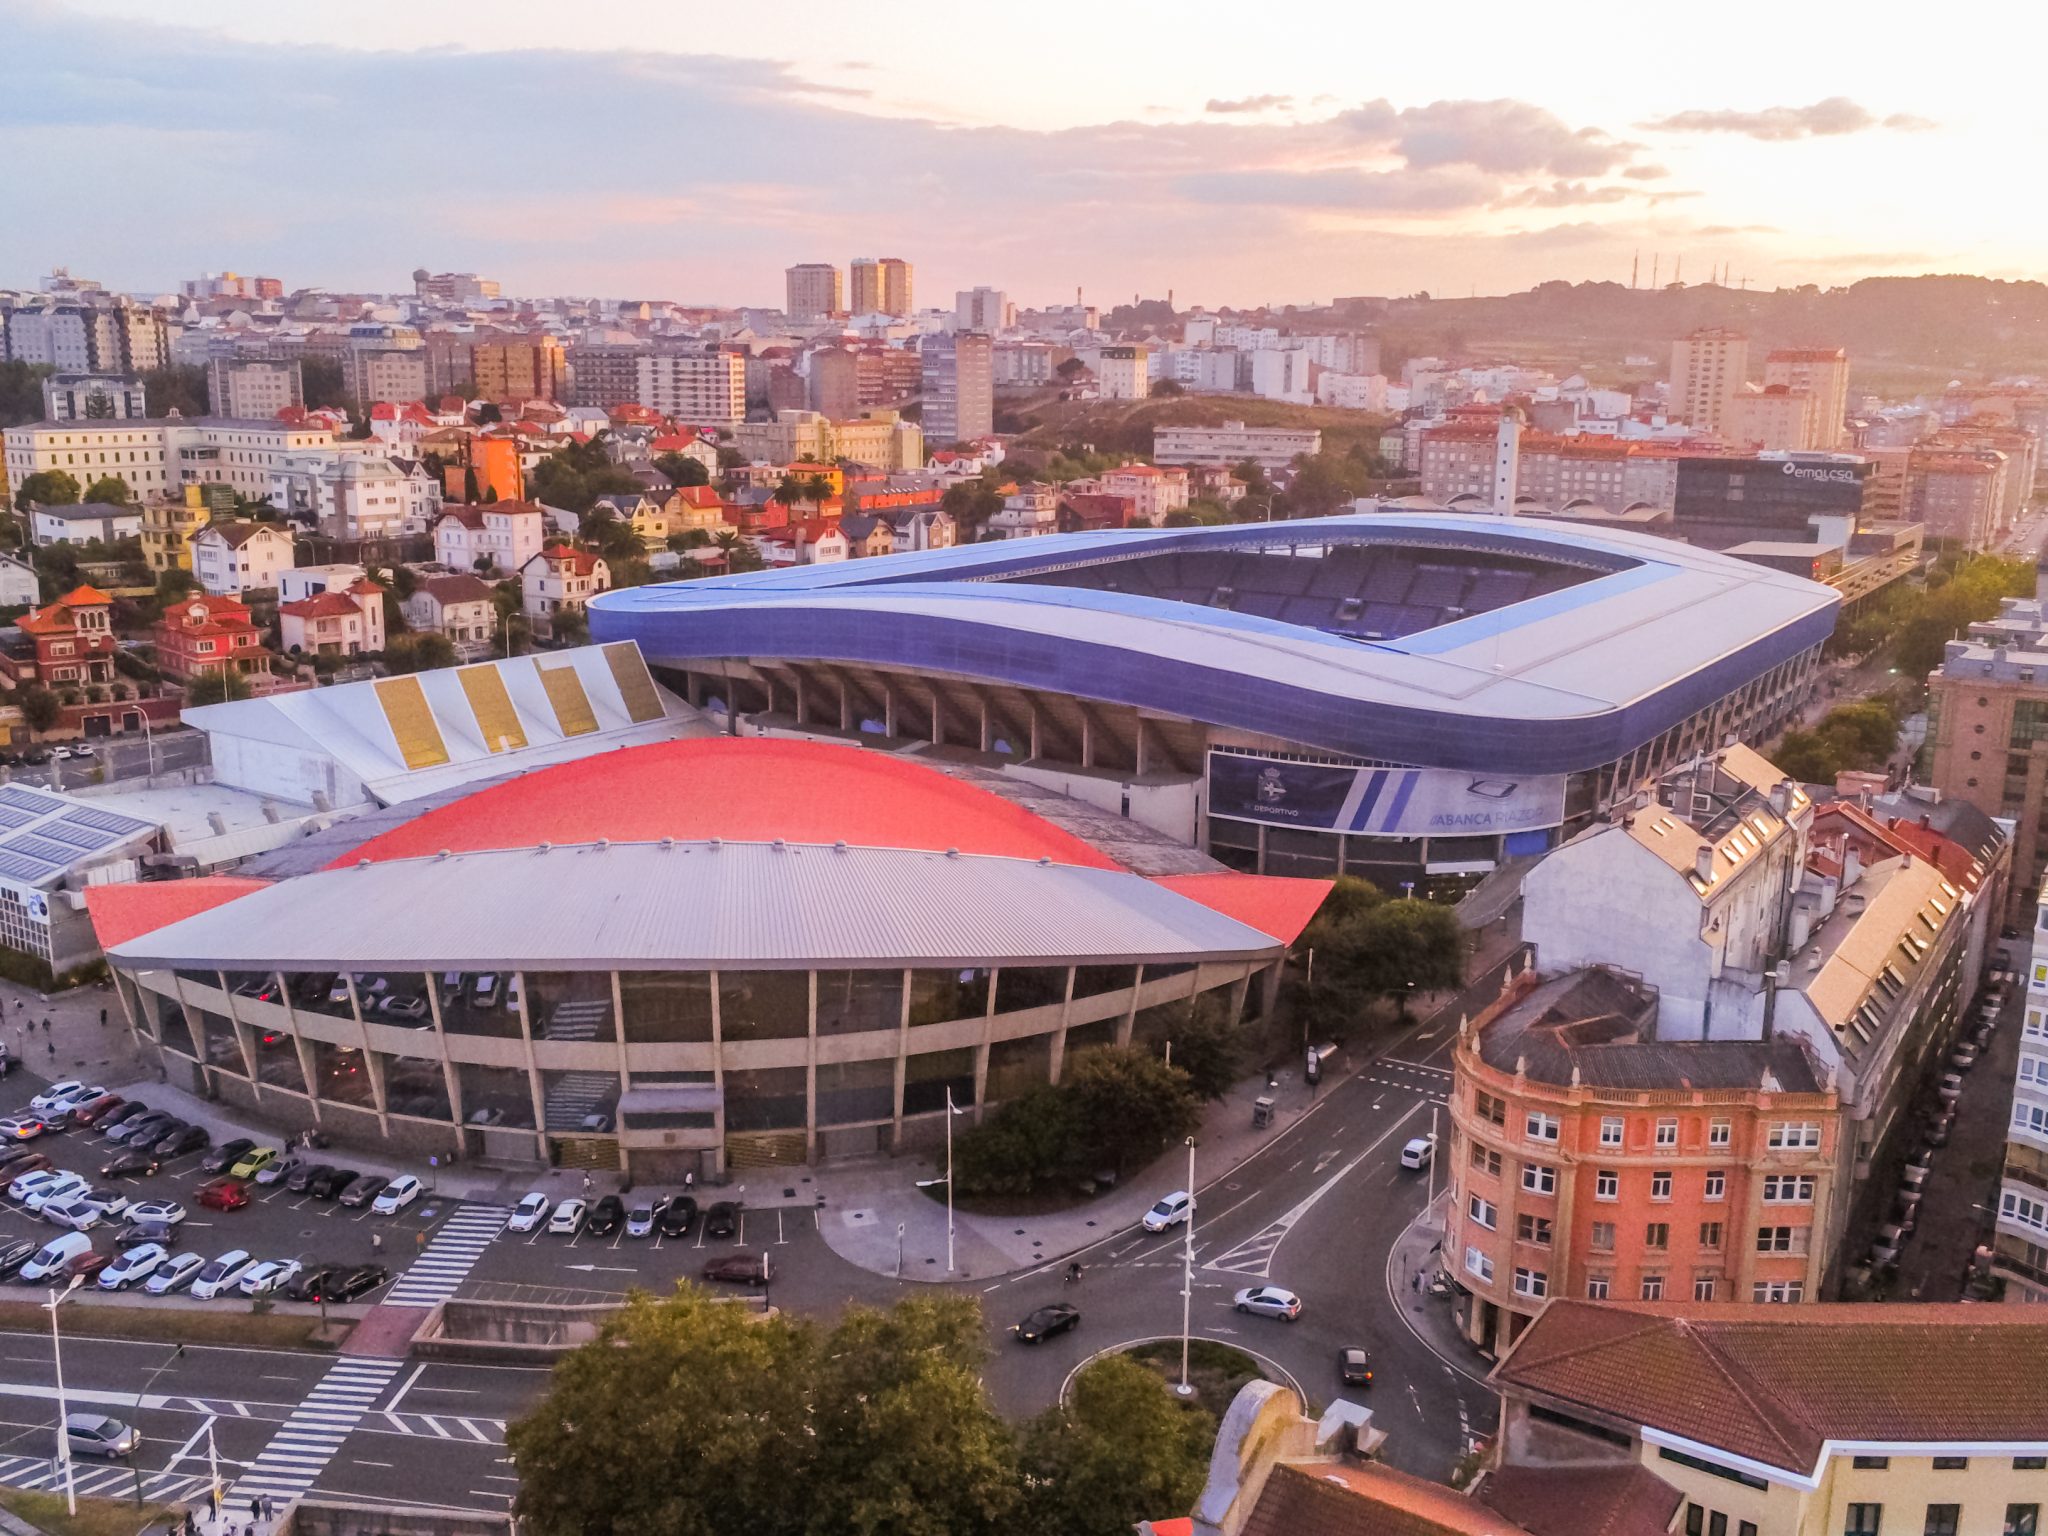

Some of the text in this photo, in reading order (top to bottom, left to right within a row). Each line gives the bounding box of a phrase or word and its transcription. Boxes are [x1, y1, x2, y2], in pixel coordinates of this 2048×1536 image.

[1794, 468, 1854, 480] emalcsa
[1254, 804, 1299, 817] DEPORTIVO
[1434, 807, 1545, 826] ABANCA RIAZOR
